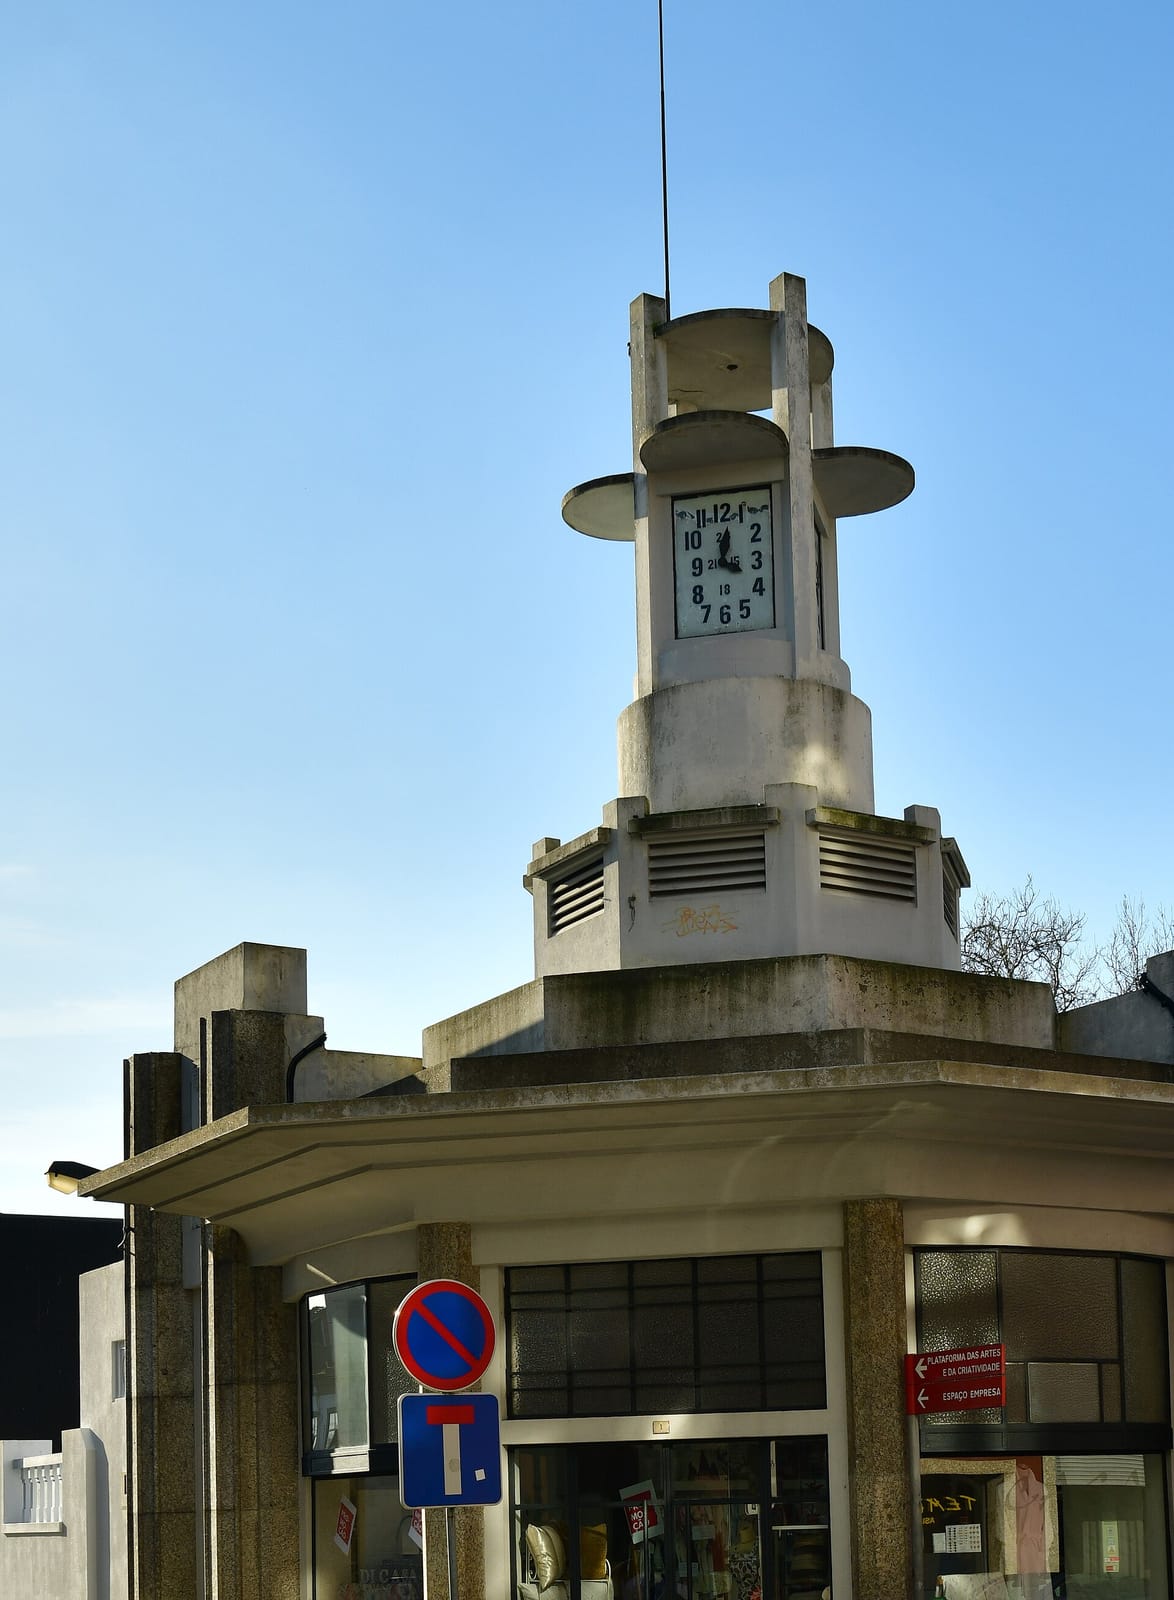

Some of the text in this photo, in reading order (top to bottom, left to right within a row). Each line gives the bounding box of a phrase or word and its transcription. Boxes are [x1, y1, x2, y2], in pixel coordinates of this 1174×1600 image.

[696, 509, 706, 529] 11
[713, 503, 731, 524] 12
[738, 503, 744, 523] 1
[685, 530, 702, 551] 10
[750, 523, 762, 543] 2
[692, 557, 703, 577] 9
[707, 559, 717, 570] 21
[751, 550, 763, 570] 3
[692, 585, 704, 605] 8
[719, 584, 731, 596] 18
[752, 577, 766, 596] 4
[700, 604, 712, 624] 7
[719, 604, 731, 625] 6
[739, 599, 751, 619] 5
[927, 1348, 1001, 1365] PLATAFORMA DAS ARTES
[942, 1362, 1001, 1377] E DA CRIATIVIDADE
[942, 1387, 1001, 1402] ESPAÇO EMPRESA
